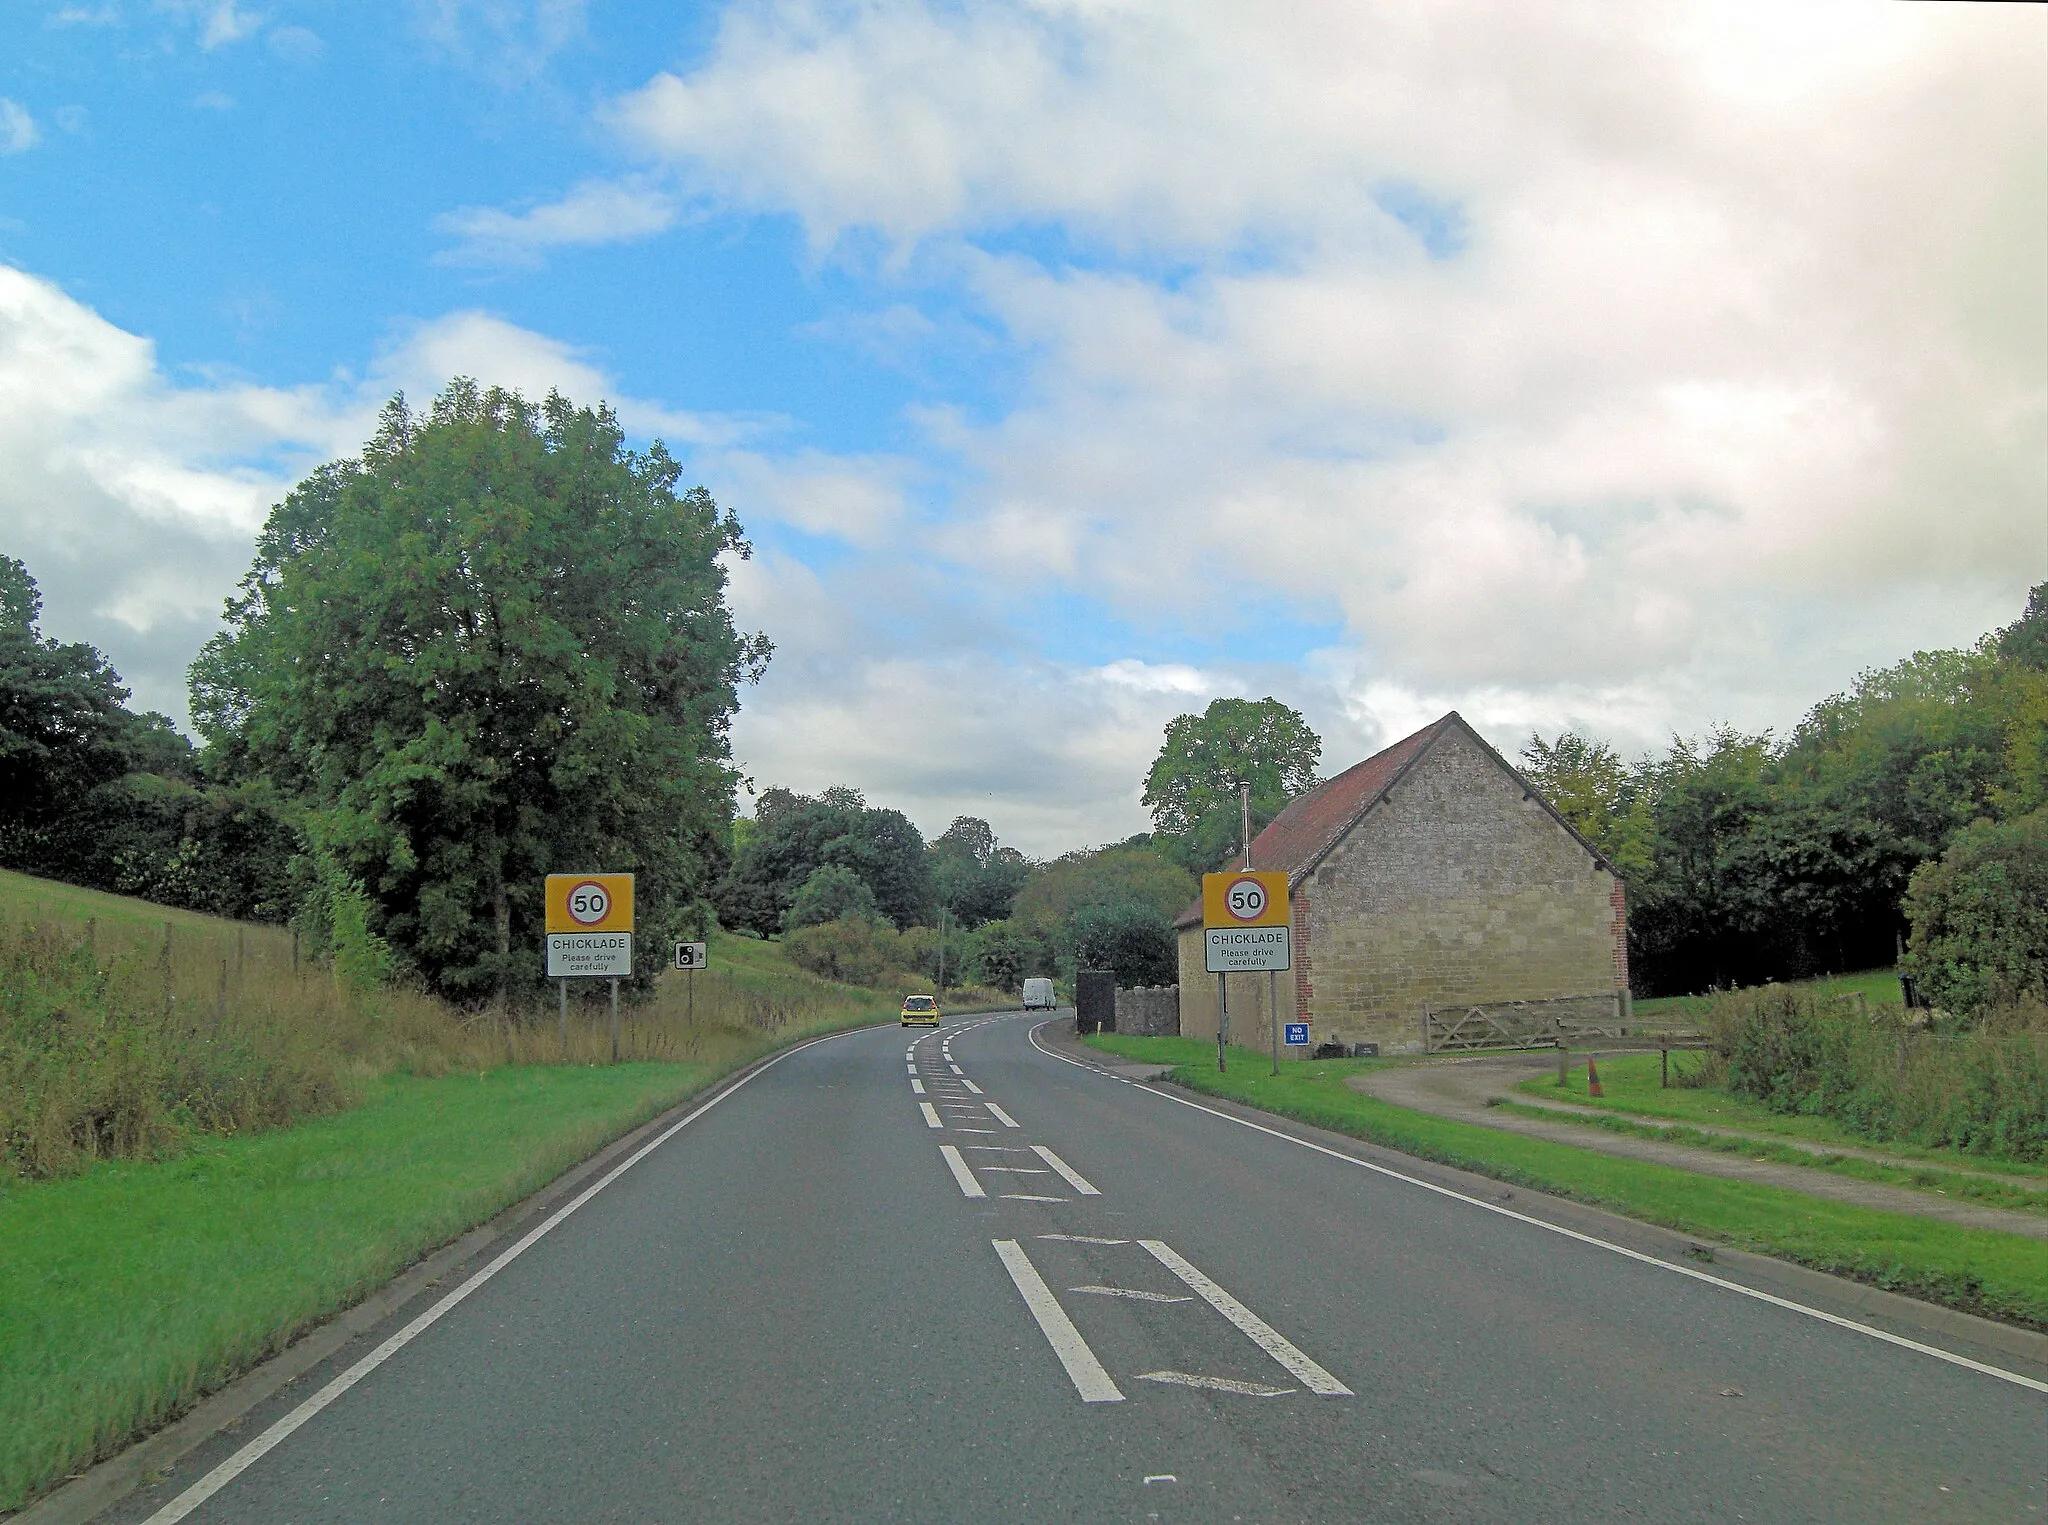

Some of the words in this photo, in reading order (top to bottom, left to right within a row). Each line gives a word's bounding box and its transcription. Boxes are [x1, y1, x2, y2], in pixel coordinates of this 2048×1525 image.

[574, 895, 604, 913] 50
[1232, 892, 1262, 909] 50
[552, 938, 625, 950] CHICKLADE
[1211, 933, 1283, 945] CHICKLADE
[562, 954, 590, 962] Please
[594, 953, 616, 962] drive
[1221, 949, 1249, 957] Please
[1252, 948, 1274, 957] drive
[570, 963, 609, 971] carefully
[1228, 958, 1267, 966] carefully
